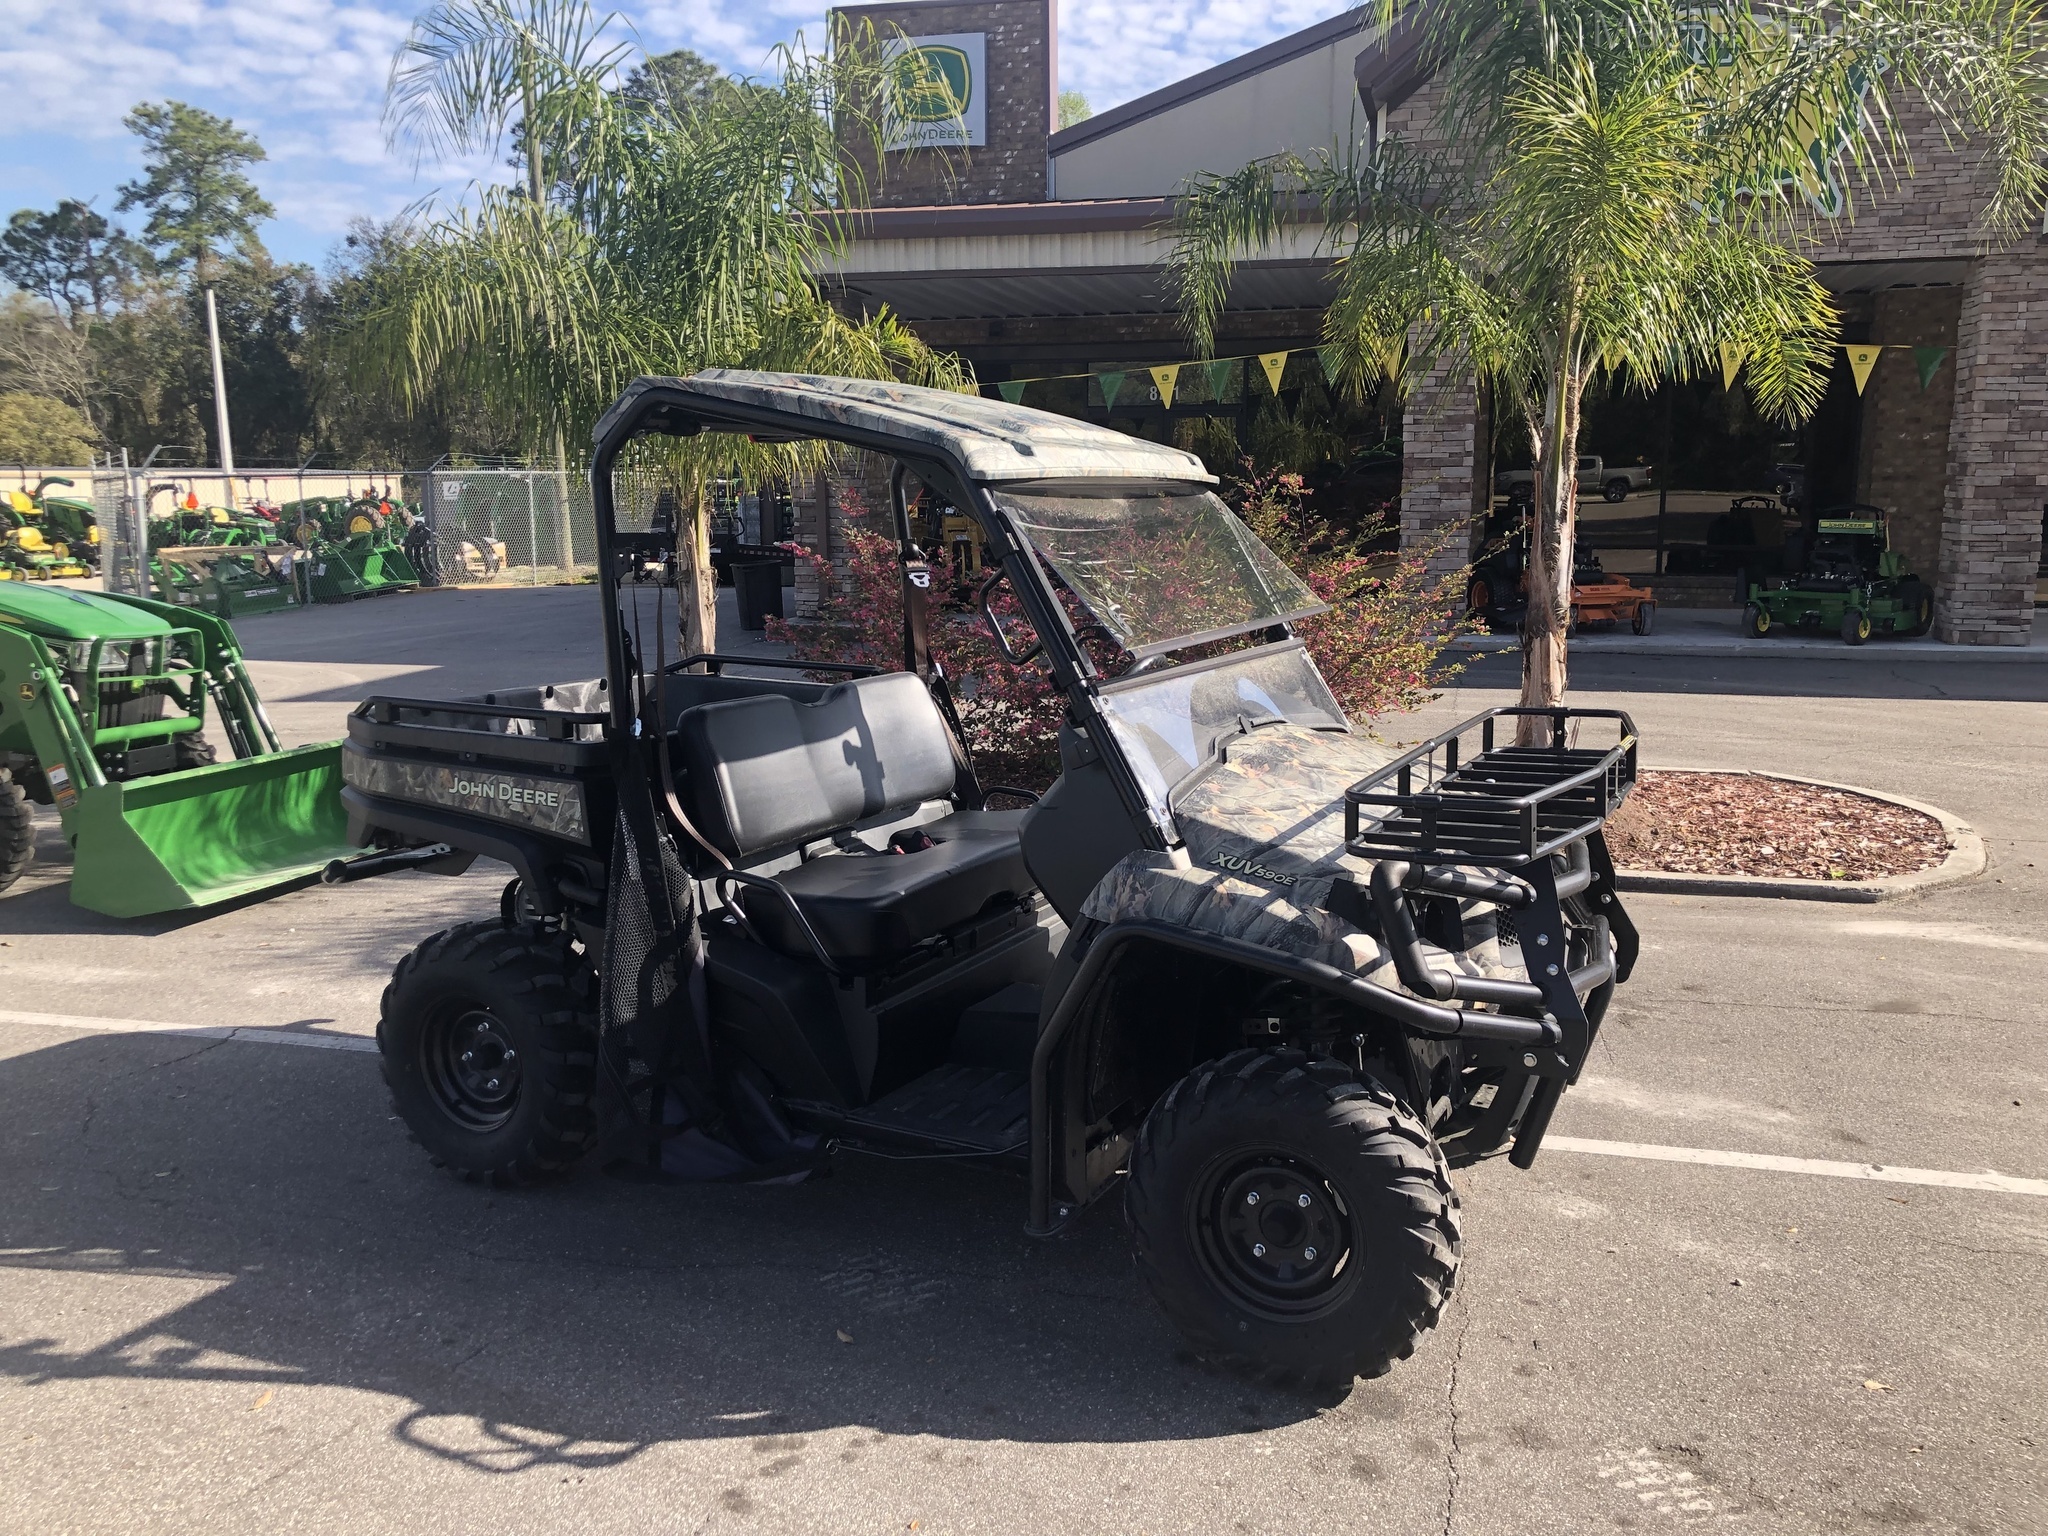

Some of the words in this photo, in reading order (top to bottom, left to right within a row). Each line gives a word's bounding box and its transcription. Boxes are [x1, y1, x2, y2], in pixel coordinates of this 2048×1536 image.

[928, 129, 973, 139] DEERE
[1150, 386, 1179, 400] 81
[449, 777, 495, 798] JOHN
[499, 783, 558, 807] DEERE
[1209, 852, 1297, 886] XUV590E
